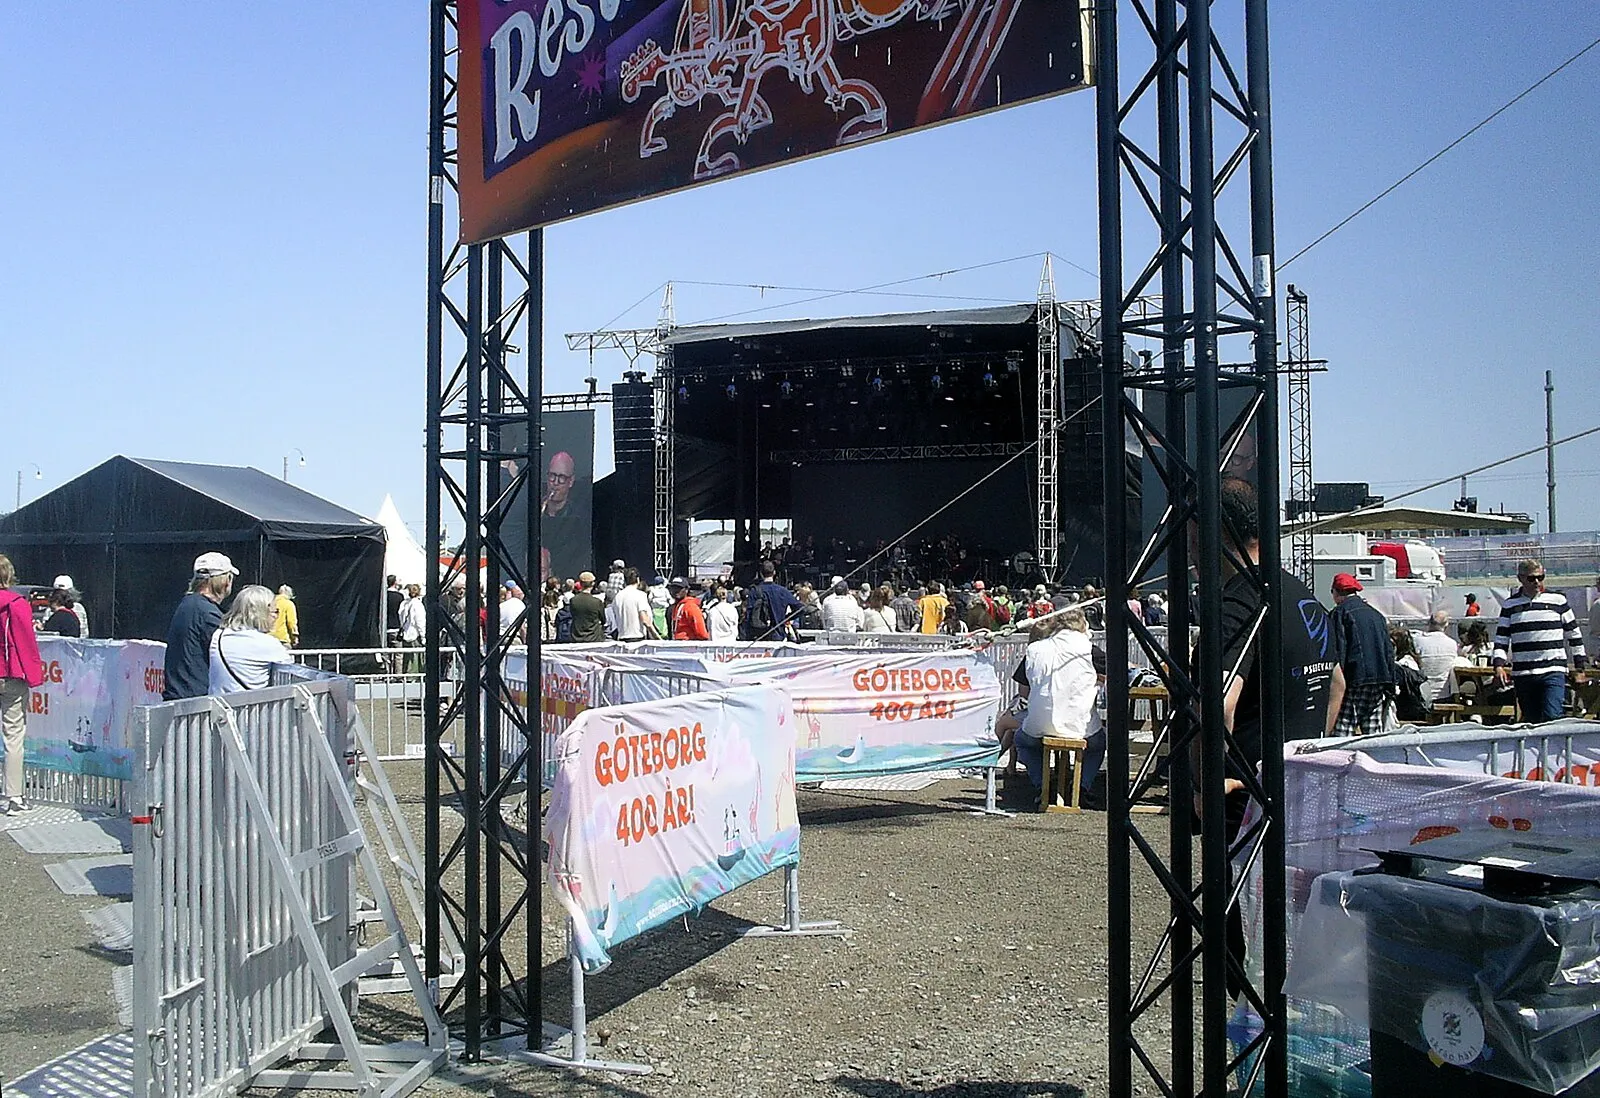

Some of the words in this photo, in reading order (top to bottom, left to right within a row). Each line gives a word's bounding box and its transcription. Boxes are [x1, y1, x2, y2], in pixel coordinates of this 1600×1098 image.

[853, 663, 973, 692] GÖTEBORG
[869, 701, 914, 721] 400
[918, 694, 956, 719] ÅR!
[595, 722, 707, 787] GÖTEBORG
[616, 794, 659, 847] 400
[662, 776, 696, 832] ÅR!
